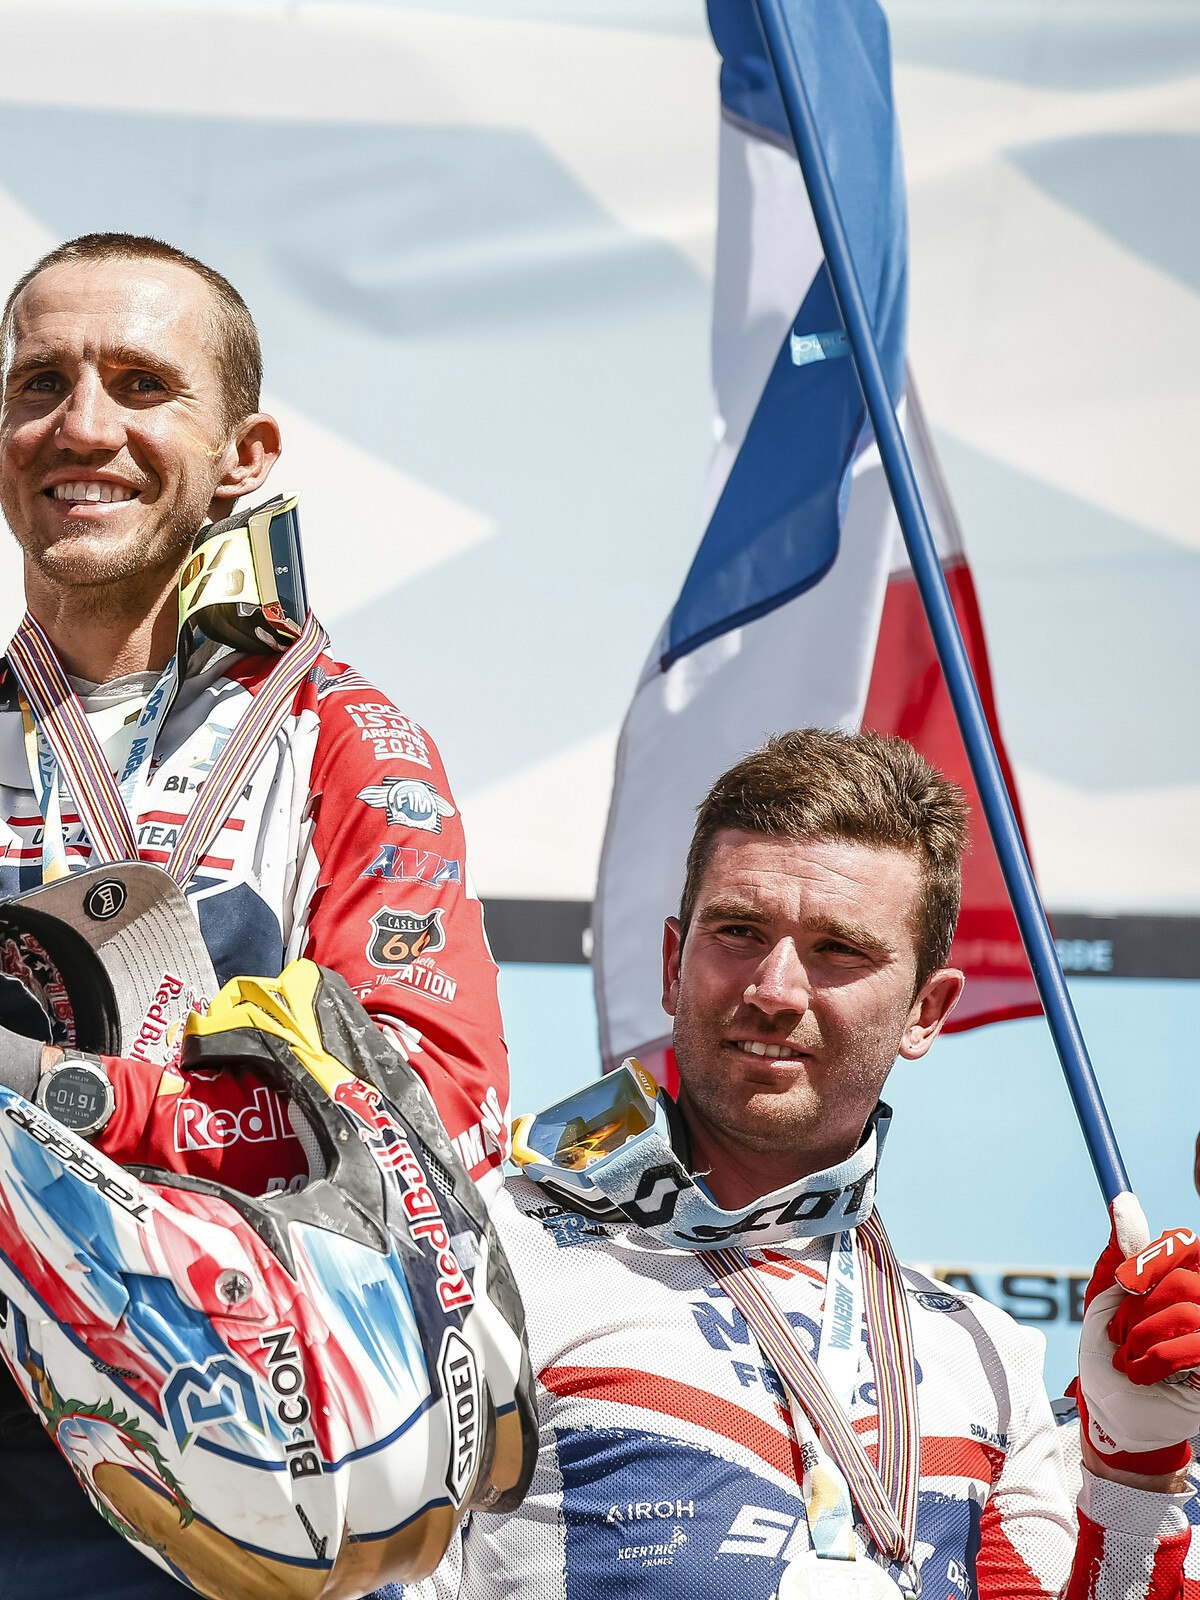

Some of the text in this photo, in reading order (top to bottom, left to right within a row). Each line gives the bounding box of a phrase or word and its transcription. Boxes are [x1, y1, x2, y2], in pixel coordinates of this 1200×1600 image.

[396, 790, 433, 814] FIM
[138, 825, 178, 849] TEA
[173, 1086, 278, 1153] Red
[673, 1168, 874, 1244] SCOT
[411, 1217, 477, 1314] Red
[1135, 1227, 1197, 1277] FIV
[826, 1278, 853, 1351] ARGENTINA
[448, 1353, 477, 1482] SHOEI
[606, 1500, 695, 1523] AIROH
